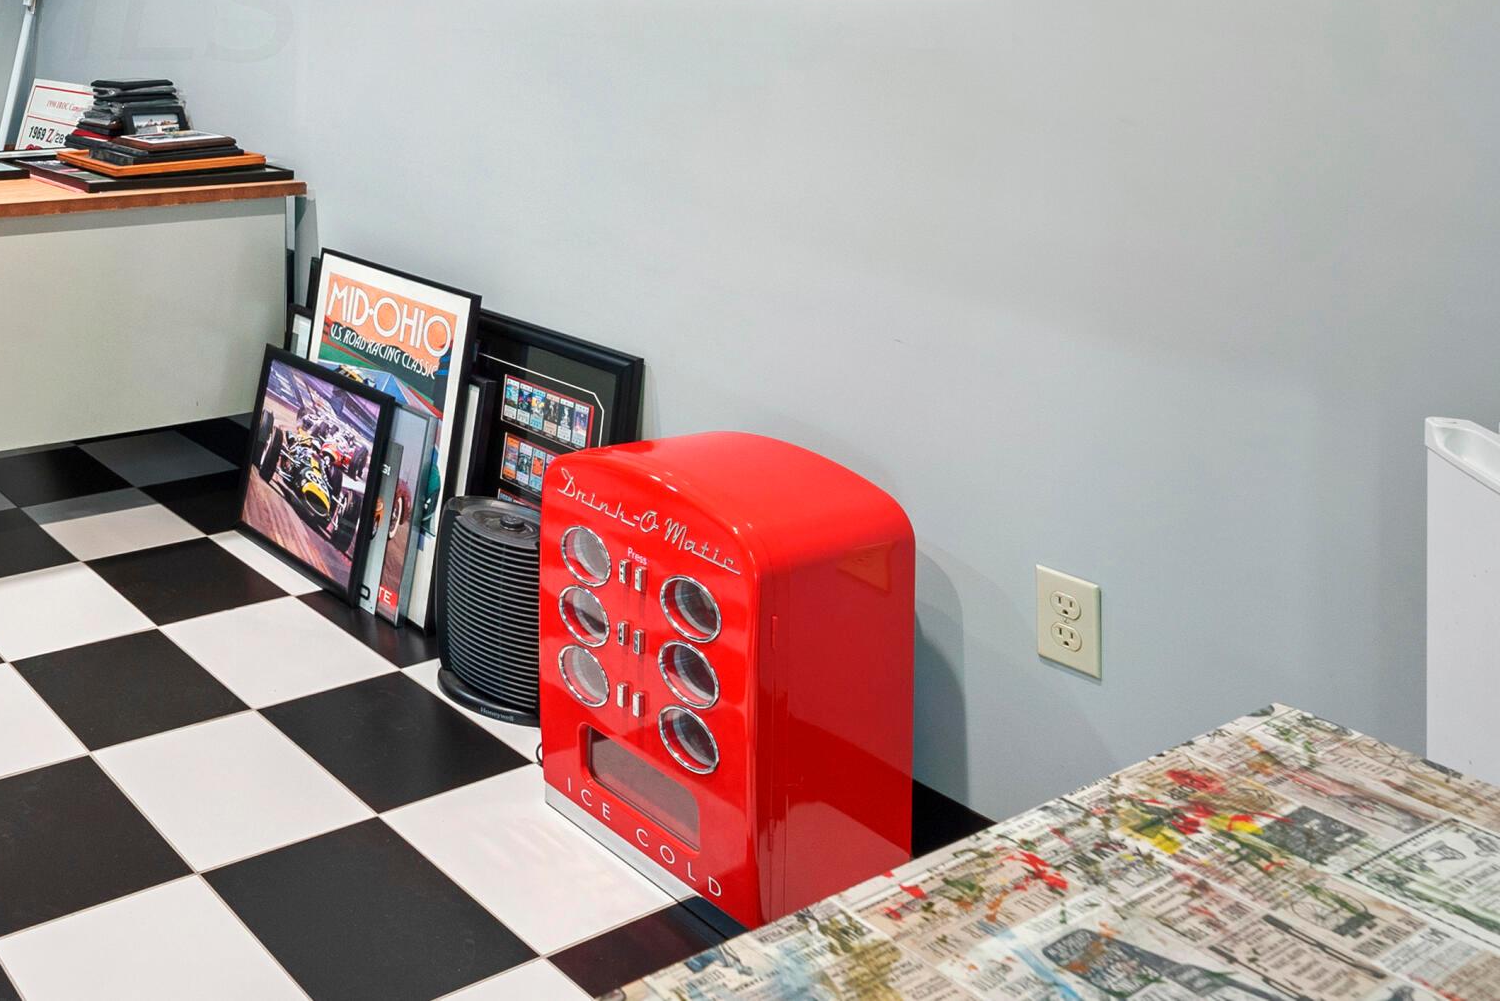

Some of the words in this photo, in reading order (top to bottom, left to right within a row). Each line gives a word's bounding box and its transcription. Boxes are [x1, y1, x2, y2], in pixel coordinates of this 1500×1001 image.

[28, 125, 47, 141] 1969
[331, 324, 342, 343] U.S.
[342, 328, 368, 351] ROAD
[366, 338, 402, 366] RACING
[402, 353, 440, 380] CLASSIC
[627, 547, 649, 565] Press
[480, 706, 514, 723] Honeywell
[567, 776, 611, 821] ICE
[636, 827, 722, 898] COLD
